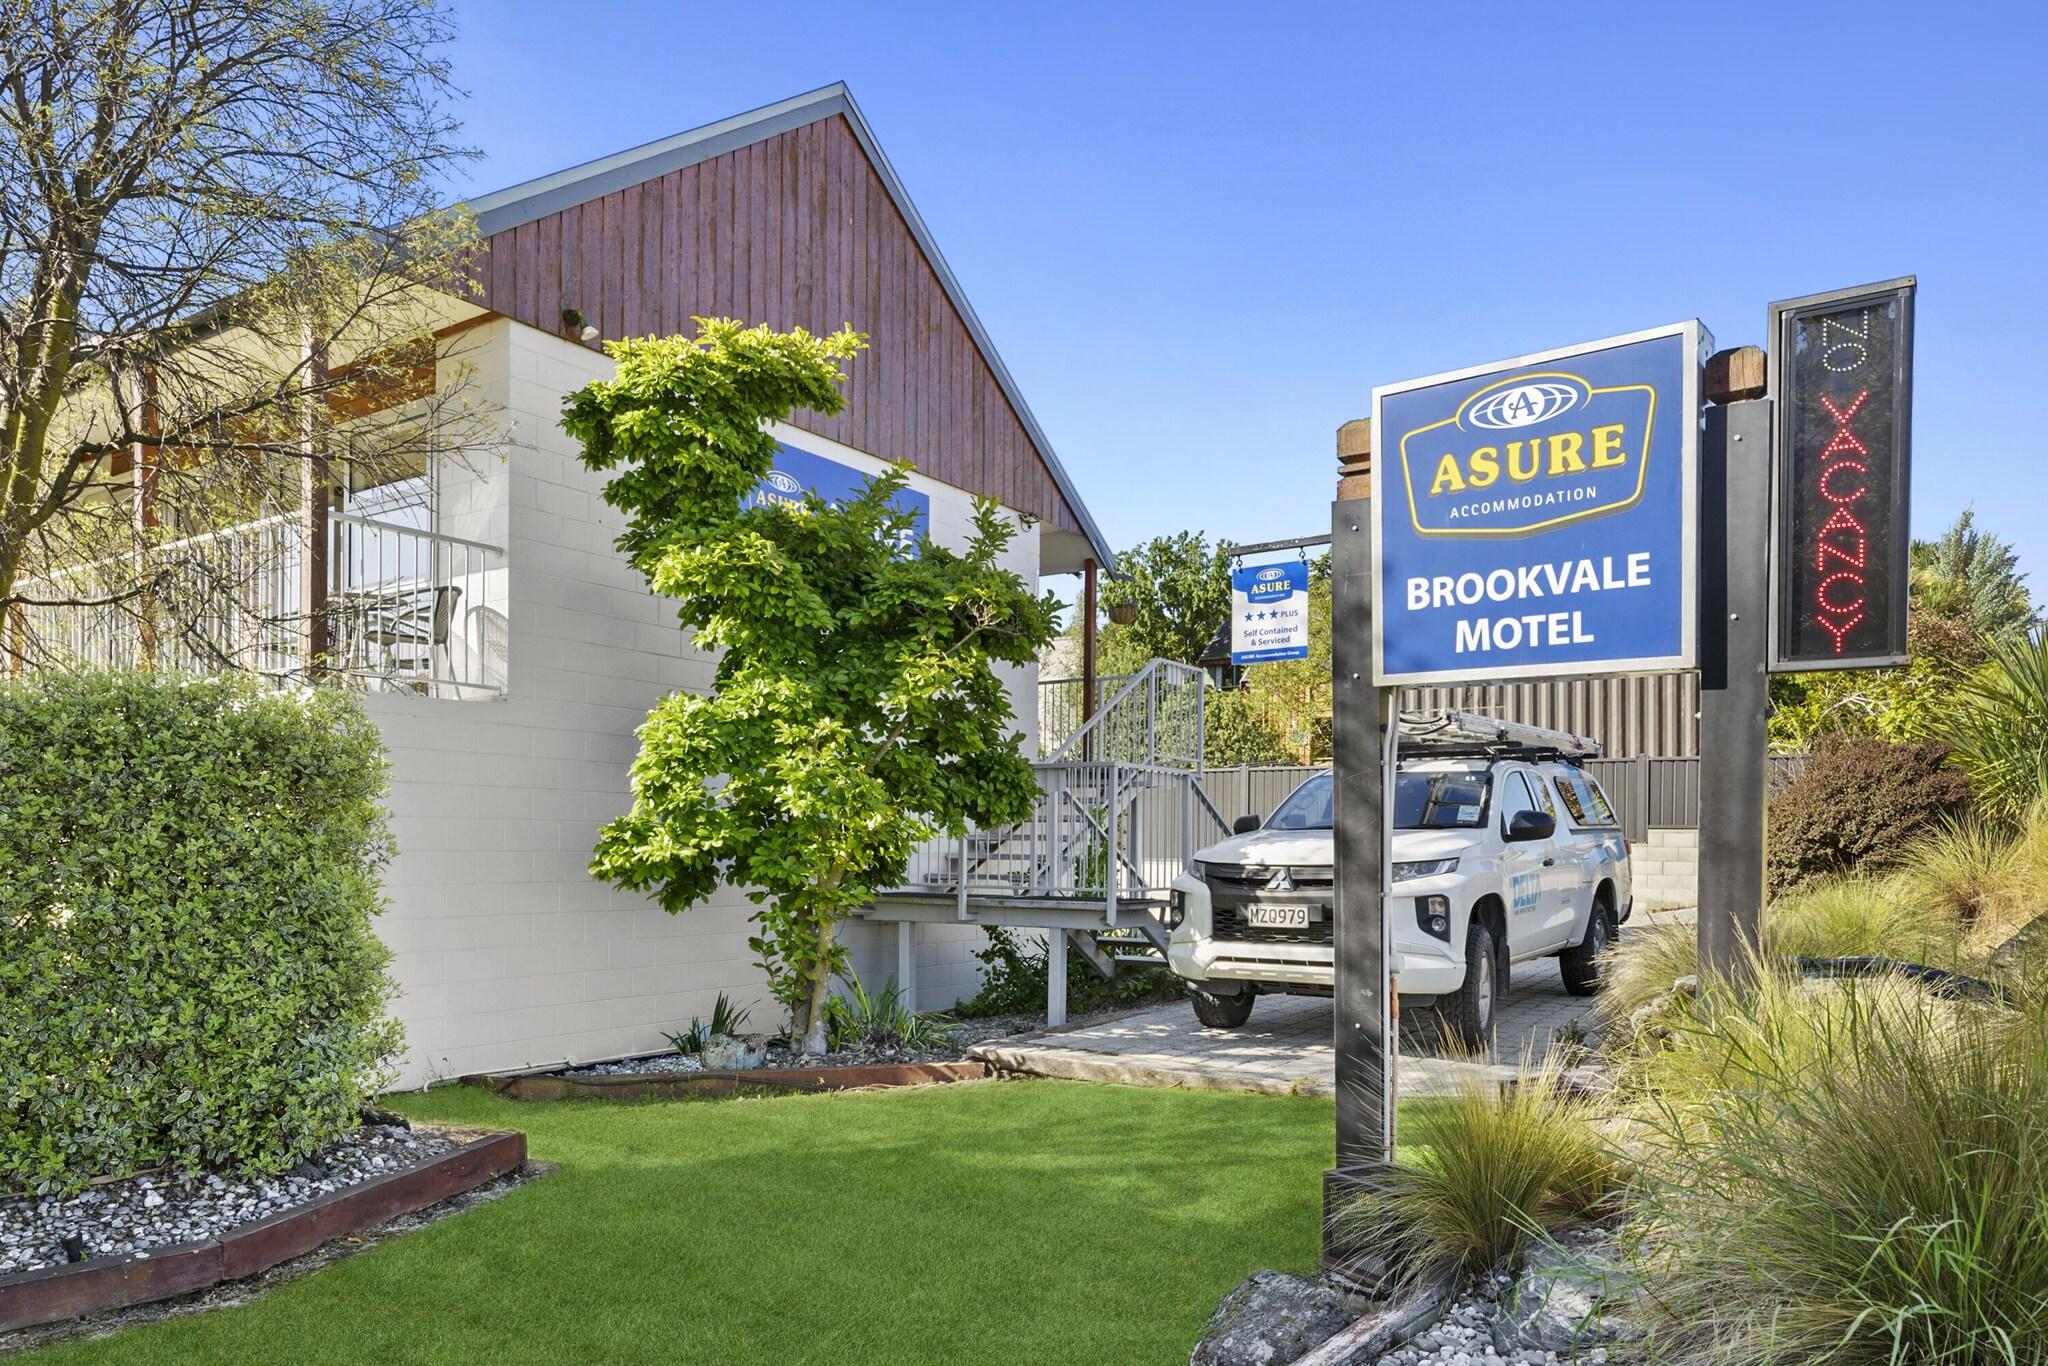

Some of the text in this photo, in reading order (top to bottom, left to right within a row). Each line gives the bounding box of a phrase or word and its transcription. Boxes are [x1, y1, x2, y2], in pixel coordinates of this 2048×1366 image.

[1430, 423, 1627, 494] ASURE
[1449, 486, 1597, 519] ACCOMMODATION
[1819, 389, 1869, 654] VACANCY
[1251, 580, 1291, 594] ASURE
[1407, 552, 1651, 611] BROOKVALE
[1280, 609, 1298, 617] PLUS
[1243, 625, 1298, 637] Self Contained
[1250, 636, 1290, 646] & Serviced
[1455, 611, 1595, 653] MOTEL
[1250, 909, 1306, 925] MZQ979
